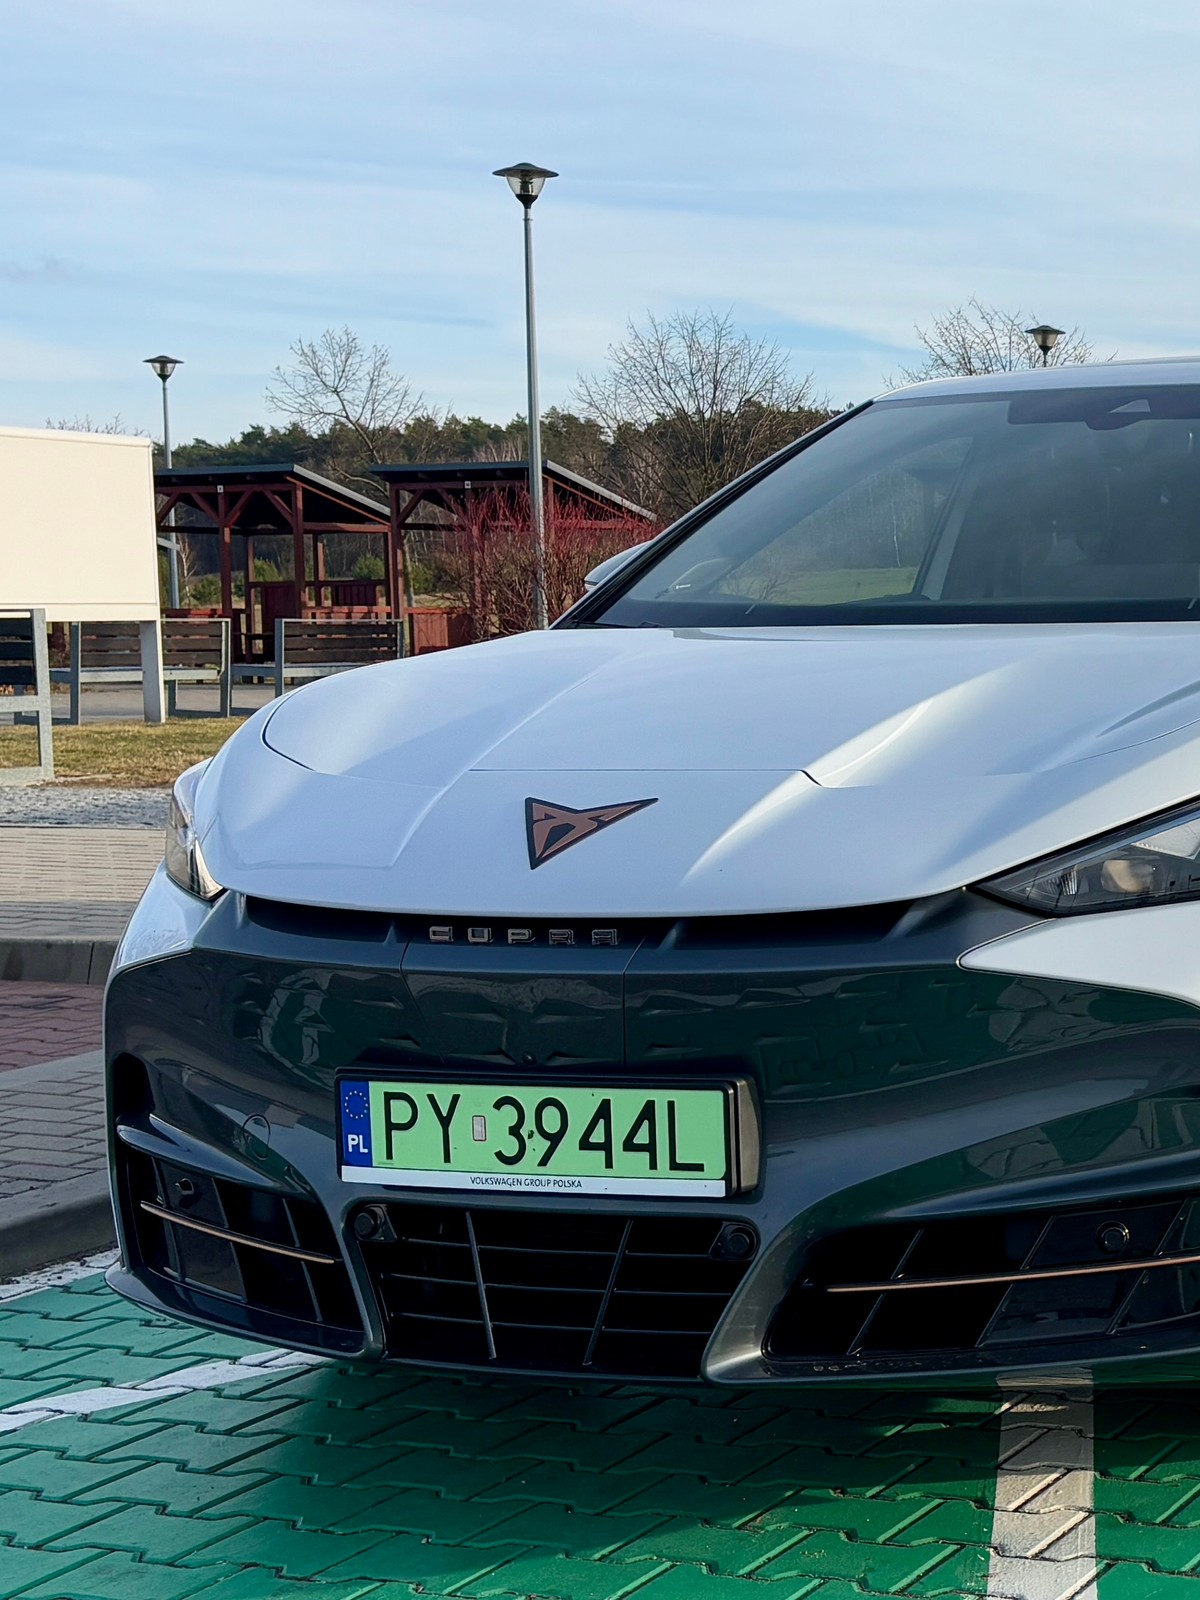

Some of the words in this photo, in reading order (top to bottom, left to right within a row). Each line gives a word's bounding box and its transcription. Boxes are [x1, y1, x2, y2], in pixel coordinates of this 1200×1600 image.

[429, 925, 619, 945] CUPRA
[384, 1091, 461, 1163] PY
[492, 1096, 704, 1172] 3944L
[347, 1134, 368, 1153] PL
[470, 1176, 522, 1187] VOLKSWAGEN
[523, 1178, 551, 1188] GROUP
[553, 1179, 582, 1188] POLSKA
